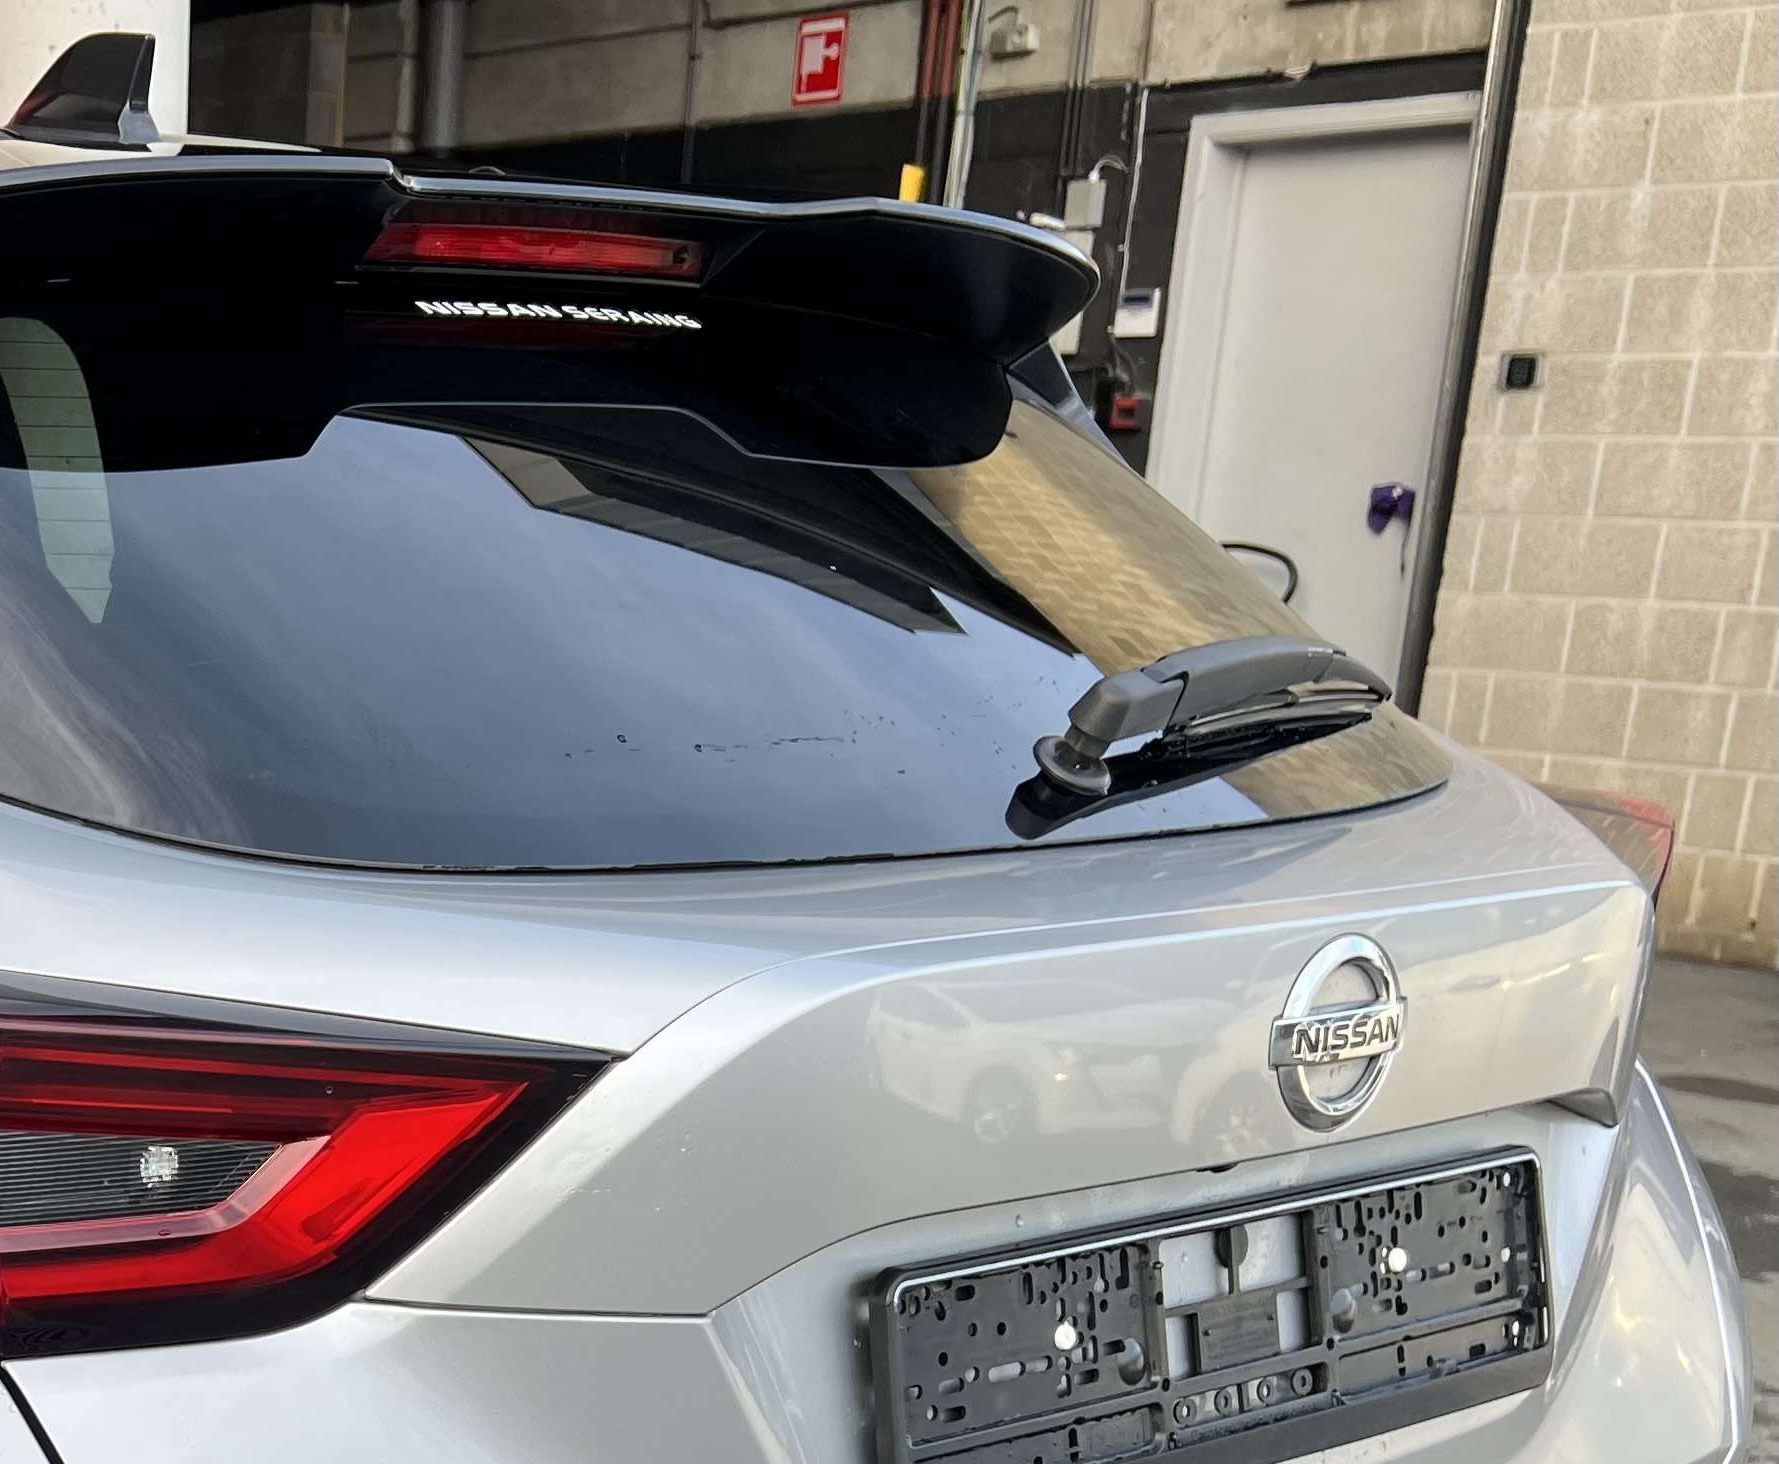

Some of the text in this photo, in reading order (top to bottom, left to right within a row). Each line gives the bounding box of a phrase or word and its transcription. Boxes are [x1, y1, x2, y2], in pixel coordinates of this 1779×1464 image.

[415, 301, 702, 329] NISSAN SERAING
[1293, 1014, 1400, 1056] NISSAN
